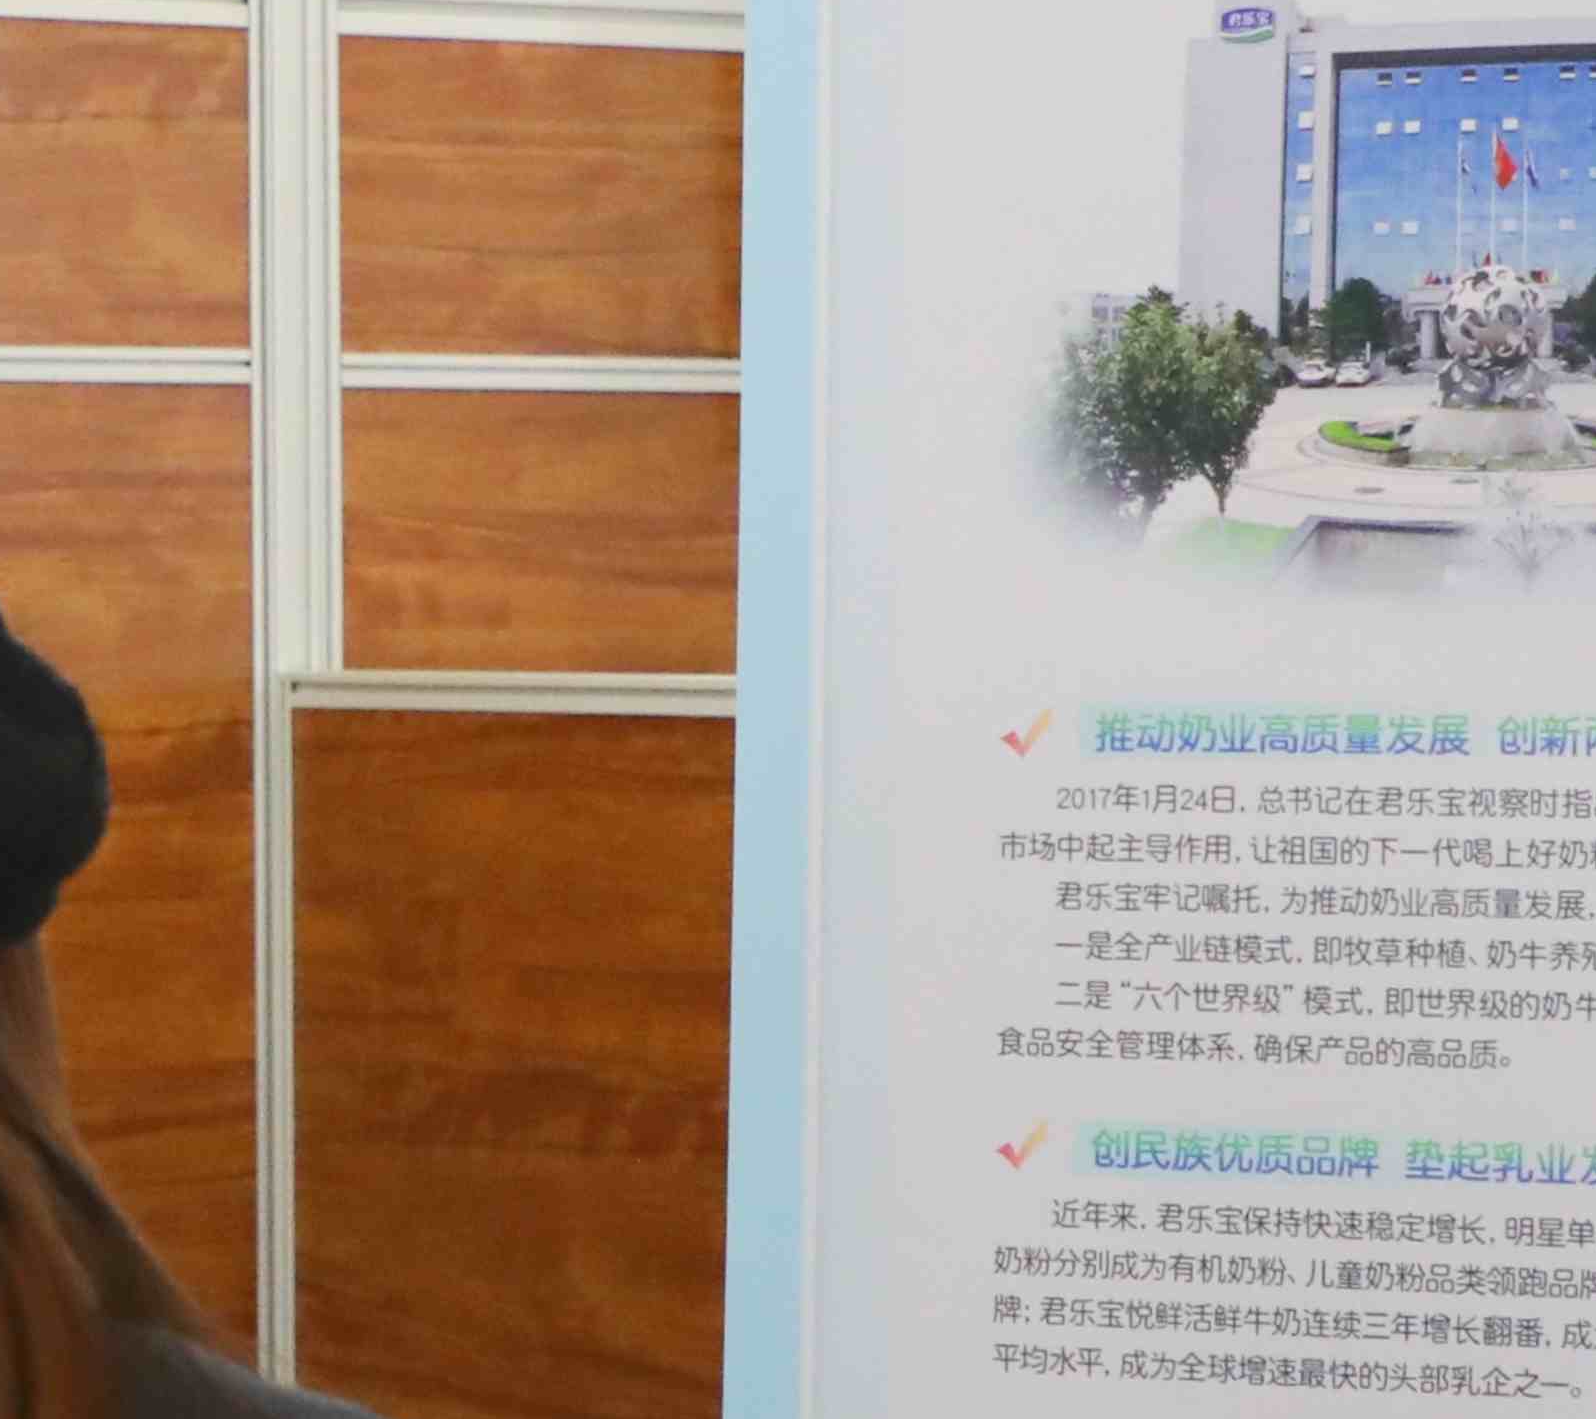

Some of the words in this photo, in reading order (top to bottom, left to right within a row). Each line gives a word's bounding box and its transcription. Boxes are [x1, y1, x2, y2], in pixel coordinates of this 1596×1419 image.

[1093, 711, 1472, 757] 推动奶业高质量发展
[1090, 1129, 1380, 1179] 创民族优质品牌
